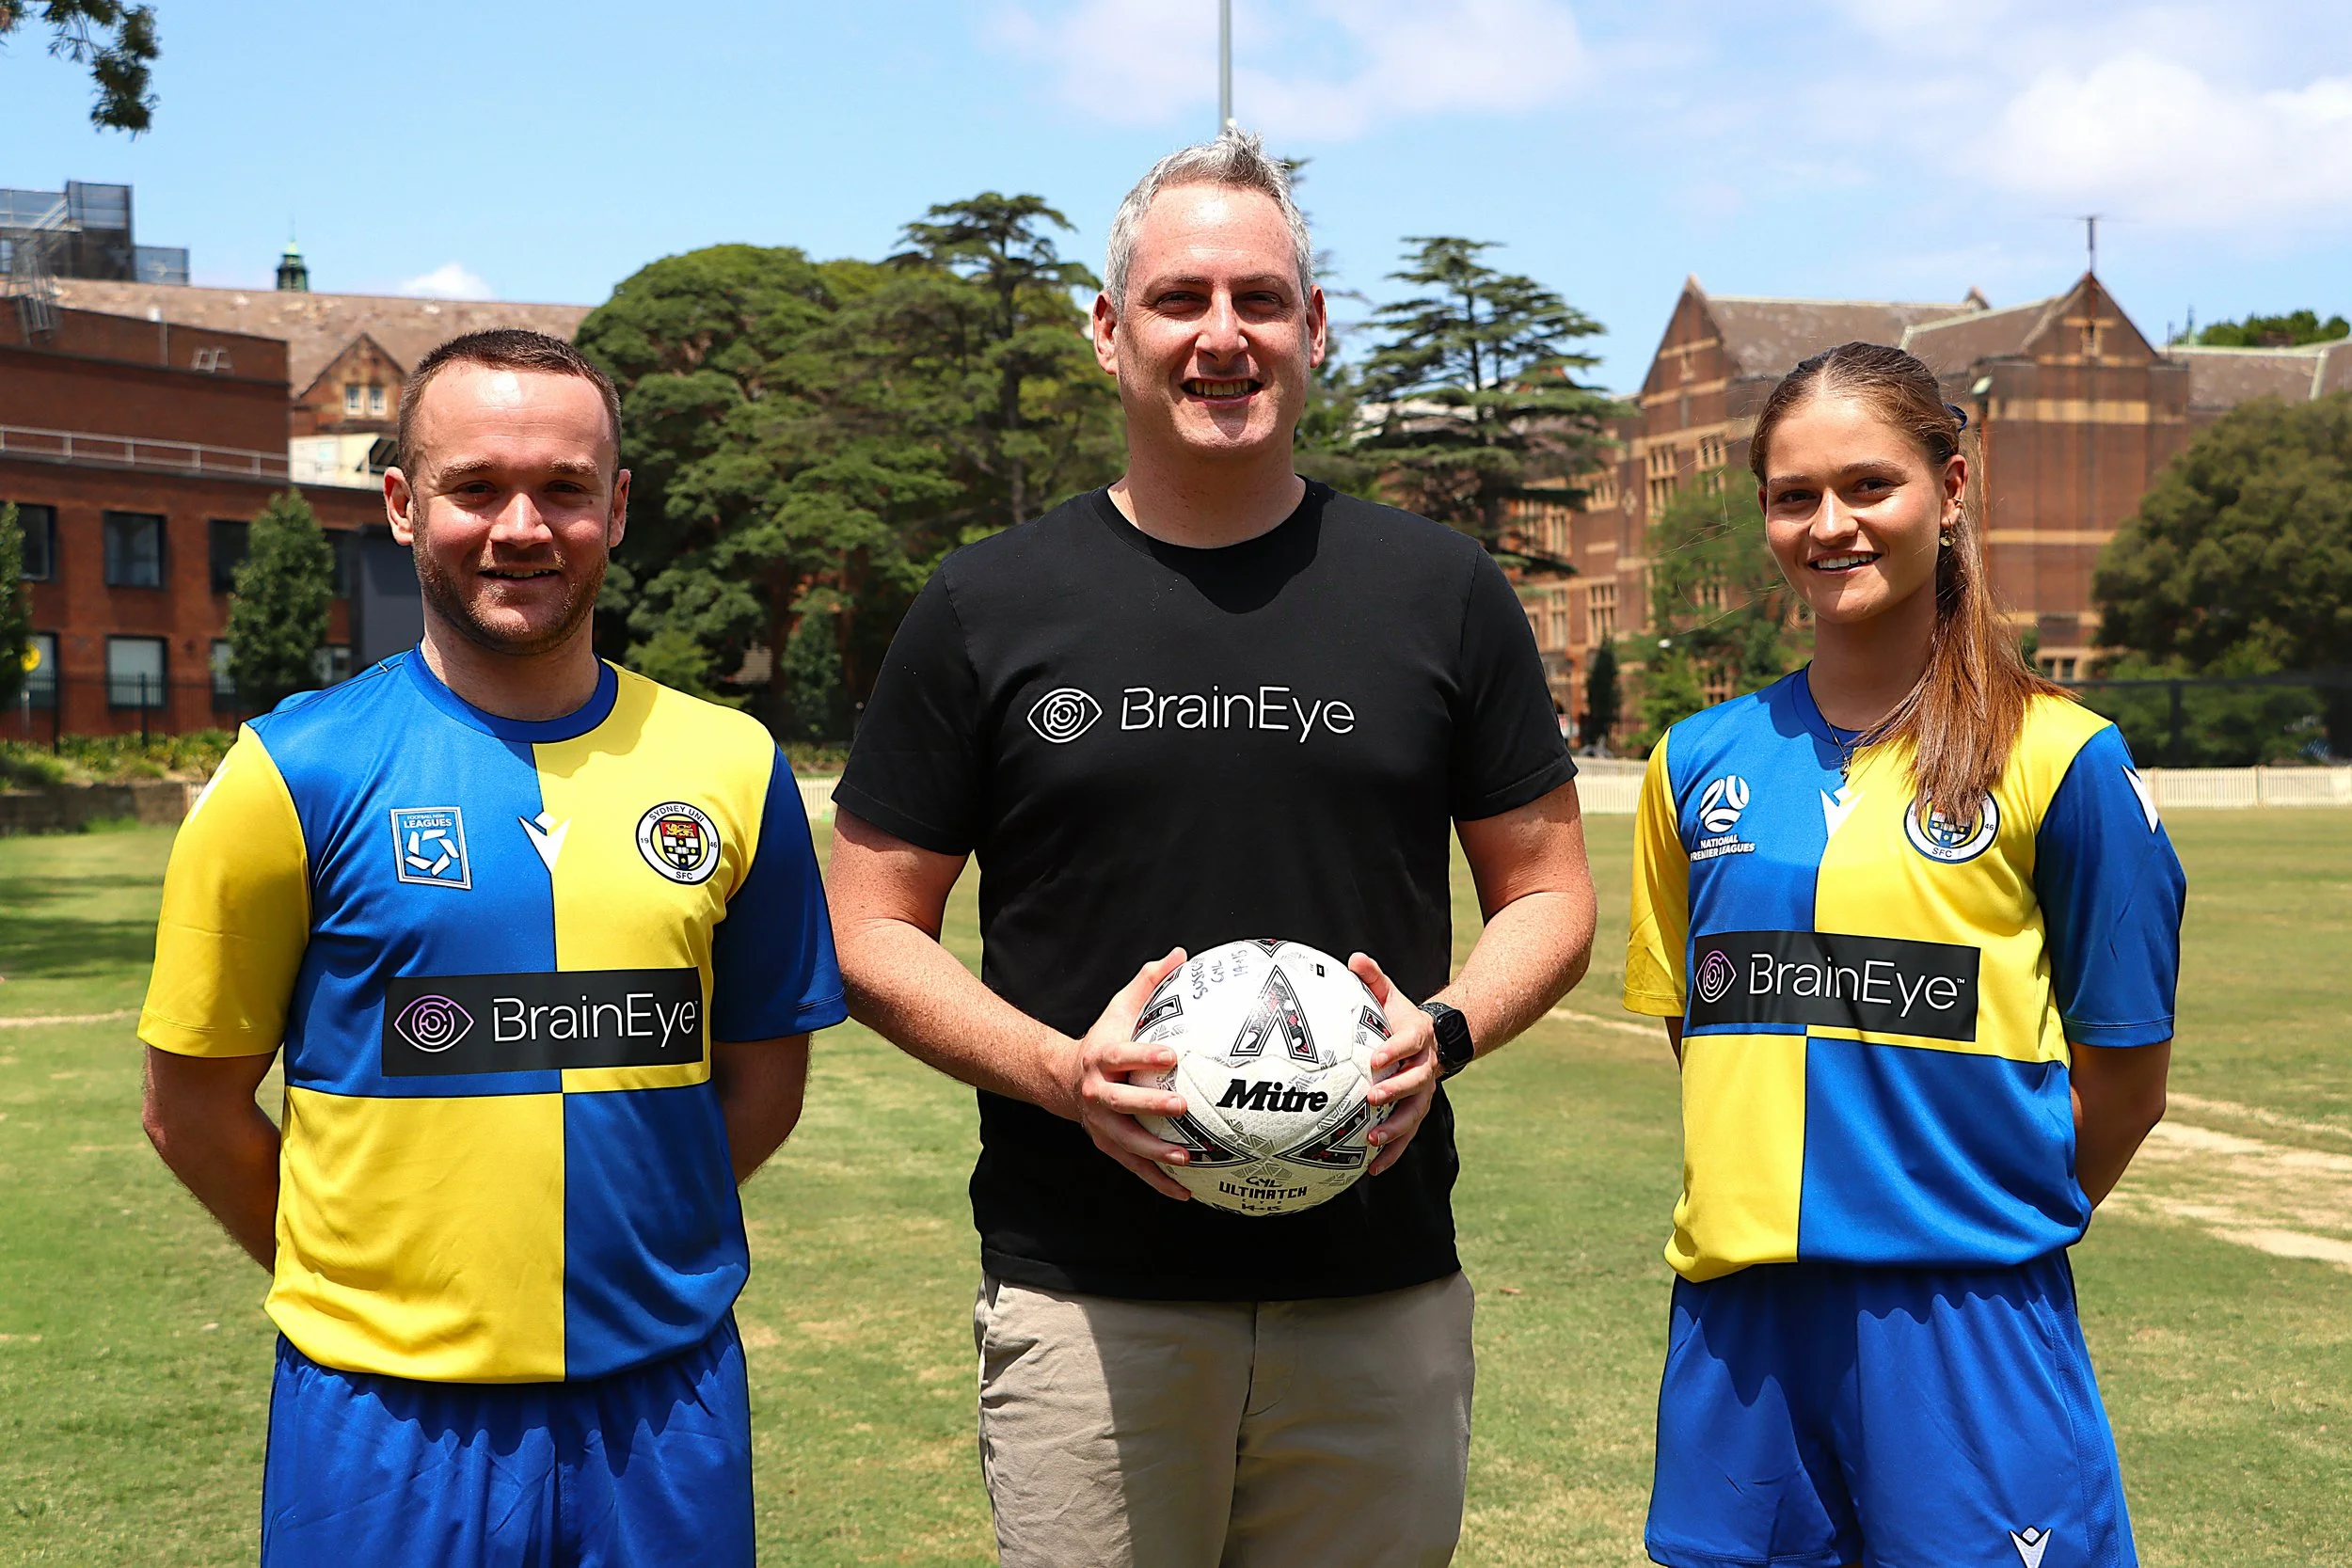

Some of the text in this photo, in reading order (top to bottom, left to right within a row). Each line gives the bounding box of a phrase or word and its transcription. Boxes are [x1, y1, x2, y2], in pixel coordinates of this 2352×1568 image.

[1120, 685, 1355, 743] BrainEye
[649, 805, 705, 822] SYDNEY UNI
[404, 818, 453, 829] LEAGUES
[1700, 834, 1739, 849] NATIONAL
[1719, 843, 1756, 856] LEAGUES
[1931, 847, 1952, 858] SFC
[675, 871, 693, 879] SFC
[1215, 1078, 1328, 1113] Mitre
[1218, 1180, 1308, 1200] ULTIMATCH
